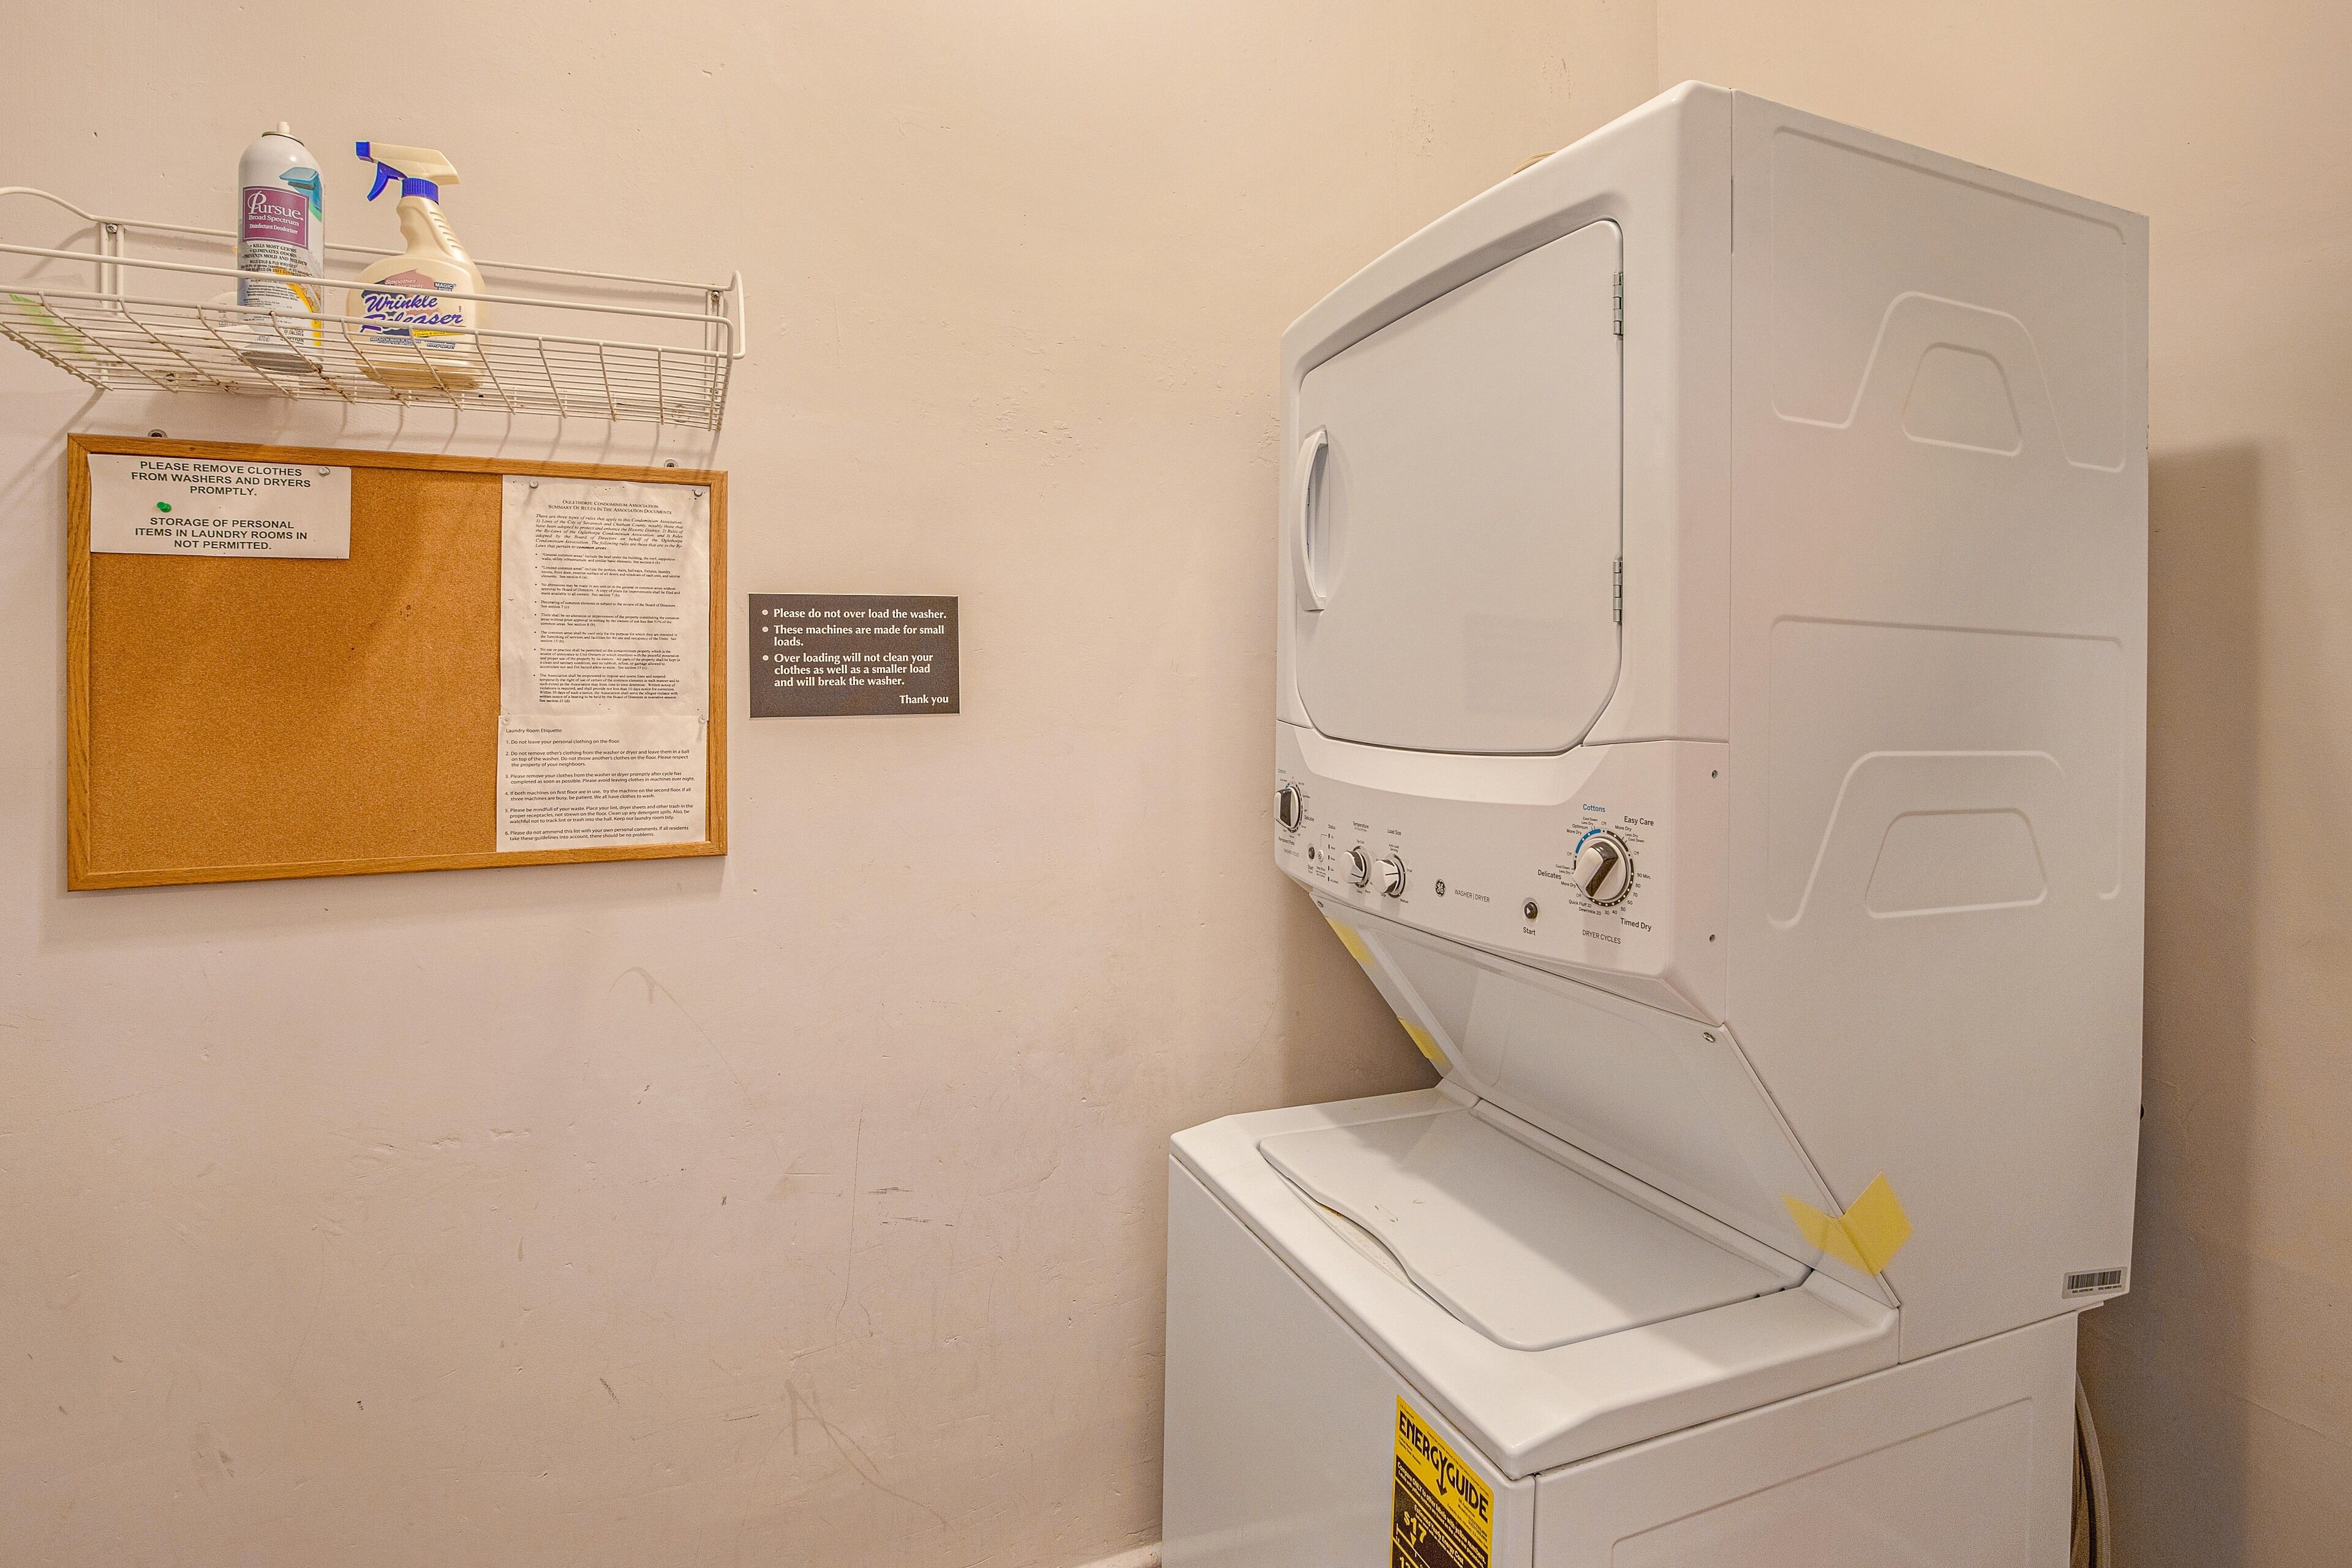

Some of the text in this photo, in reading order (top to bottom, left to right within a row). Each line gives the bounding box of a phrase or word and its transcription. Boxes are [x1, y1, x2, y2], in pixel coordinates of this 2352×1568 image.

[247, 190, 303, 221] Pursue
[267, 216, 300, 226] Spectrum
[273, 225, 298, 234] Deodorizer
[364, 295, 437, 313] Wrinkle
[140, 461, 302, 477] PLEASE REMOVE CLOTHES
[131, 472, 168, 481] FROM
[171, 473, 232, 484] WASHERS
[264, 478, 311, 488] DRYERS
[190, 486, 257, 496] PROMPTLY.
[150, 517, 209, 527] STORAGE
[232, 520, 295, 529] PERSONAL
[135, 528, 172, 537] ITEMS
[192, 530, 247, 538] LAUNDRY
[174, 540, 271, 550] NOT PERMITTED.
[774, 608, 805, 618] Please
[808, 608, 821, 618] do
[824, 609, 841, 618] not
[868, 608, 889, 618] load
[892, 609, 908, 618] the
[910, 609, 946, 619] washer.
[773, 624, 803, 634] These
[805, 624, 853, 634] machines
[874, 625, 900, 634] made
[903, 625, 918, 634] for
[919, 625, 944, 635] small
[774, 636, 804, 646] loads.
[774, 654, 801, 663] Over
[803, 652, 840, 665] loading
[842, 652, 861, 662] will
[883, 652, 908, 662] clean
[910, 655, 933, 665] your
[774, 665, 811, 675] clothes
[826, 665, 848, 674] well
[872, 665, 907, 674] smaller
[910, 664, 930, 673] load
[774, 676, 905, 687] and will break the washer.
[899, 694, 949, 706] Thank you
[1583, 804, 1605, 813] Cottons
[1624, 816, 1638, 824] Easy
[1538, 870, 1561, 880] Delicates
[1454, 889, 1490, 903] WASHER DRYER
[1621, 918, 1651, 932] Timed Dry
[1583, 930, 1621, 944] DRYER CYCLES
[1398, 1462, 1412, 1482] Compare
[1412, 1478, 1422, 1491] ONLY
[1427, 1493, 1436, 1506] other
[1436, 1504, 1446, 1520] labels
[1455, 1526, 1467, 1542] yellow
[1404, 1511, 1427, 1543] $17
[1415, 1504, 1464, 1564] Estimated Yearly Energy Cost
